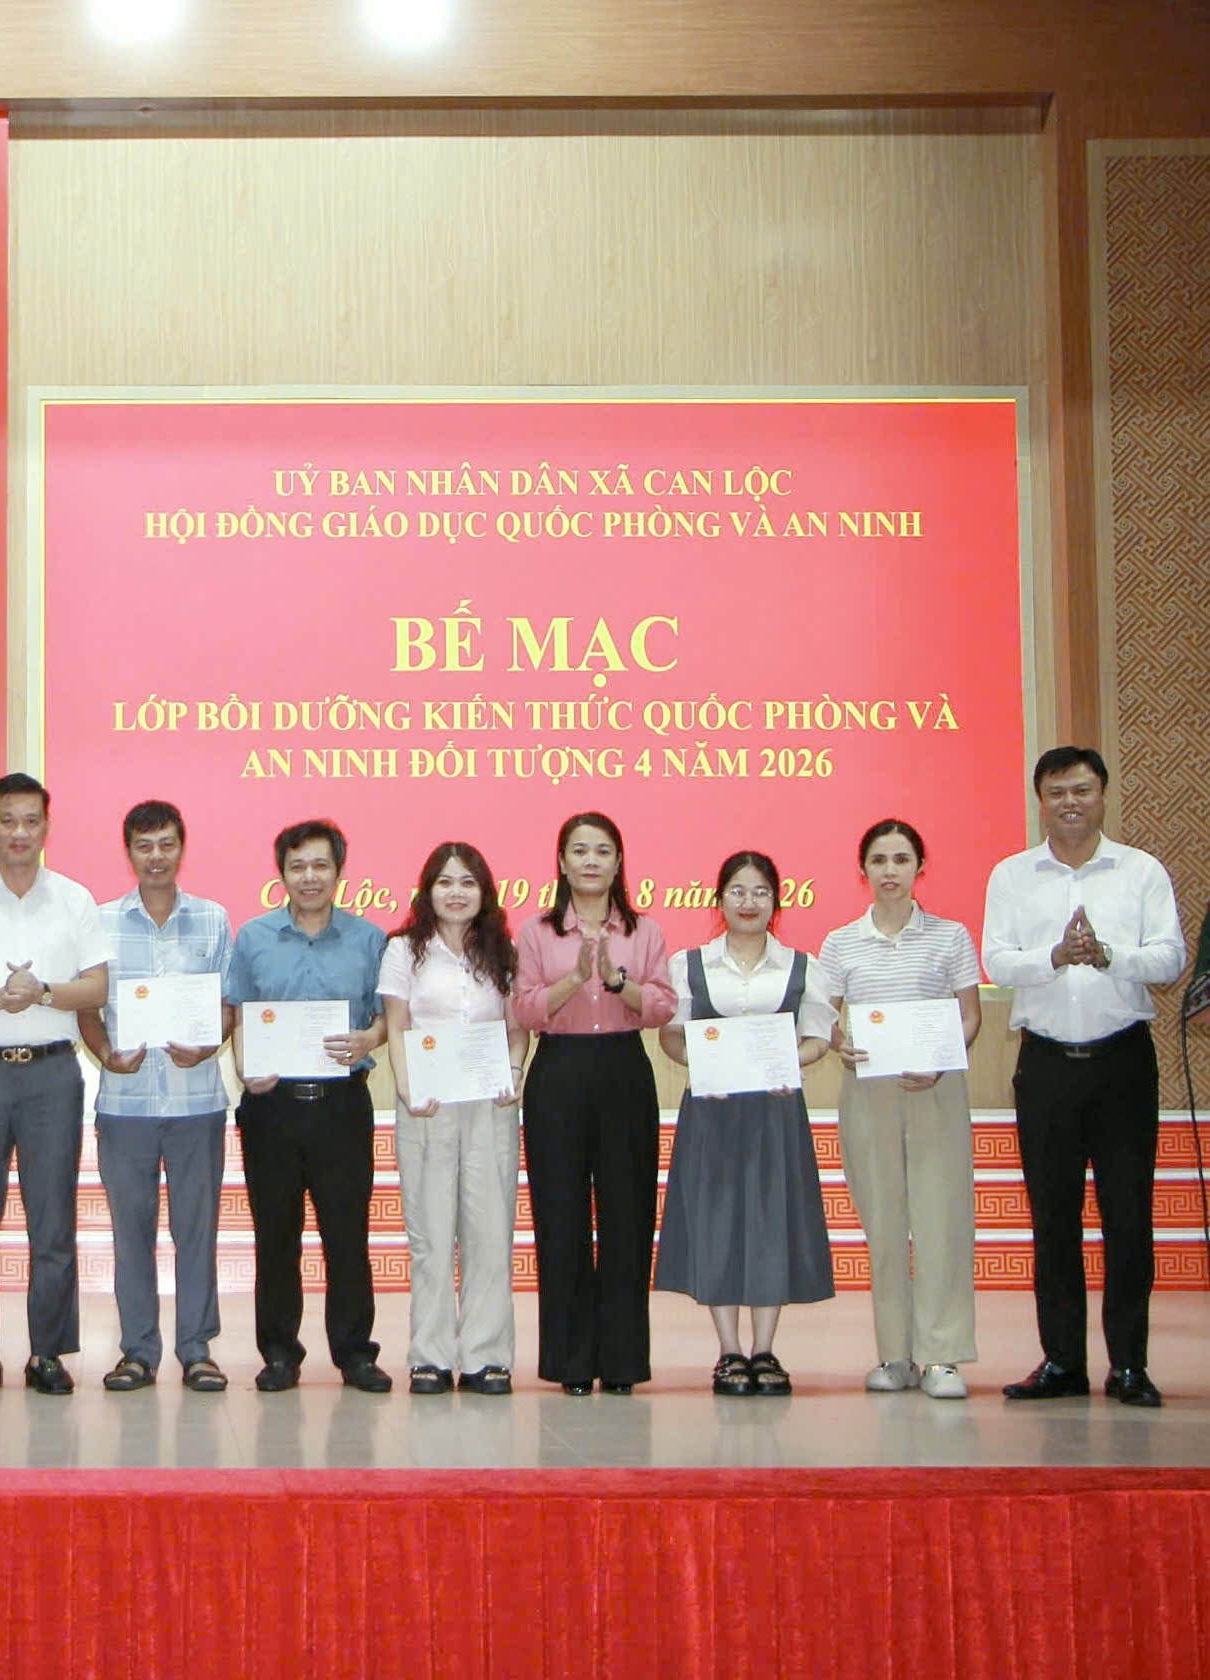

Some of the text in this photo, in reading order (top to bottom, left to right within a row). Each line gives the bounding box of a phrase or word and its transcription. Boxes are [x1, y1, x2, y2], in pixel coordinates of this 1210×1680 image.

[272, 461, 792, 502] UỶ BAN NHÂN DÂN XÃ CAN LỘC
[144, 503, 923, 545] HỘI ĐỒNG GIÁO DỤC QUỐC PHÒNG VÀ AN NINH
[390, 600, 679, 687] BẾ MẠC
[113, 692, 959, 736] LỚP BỒI DƯỠNG KIẾN THỨC QUỐC PHÒNG VÀ
[240, 740, 833, 786] AN NINH ĐỐI TƯỢNG 4 NĂM 2026
[333, 879, 398, 917] Lộc,
[497, 878, 529, 909] 19
[635, 878, 655, 908] 8
